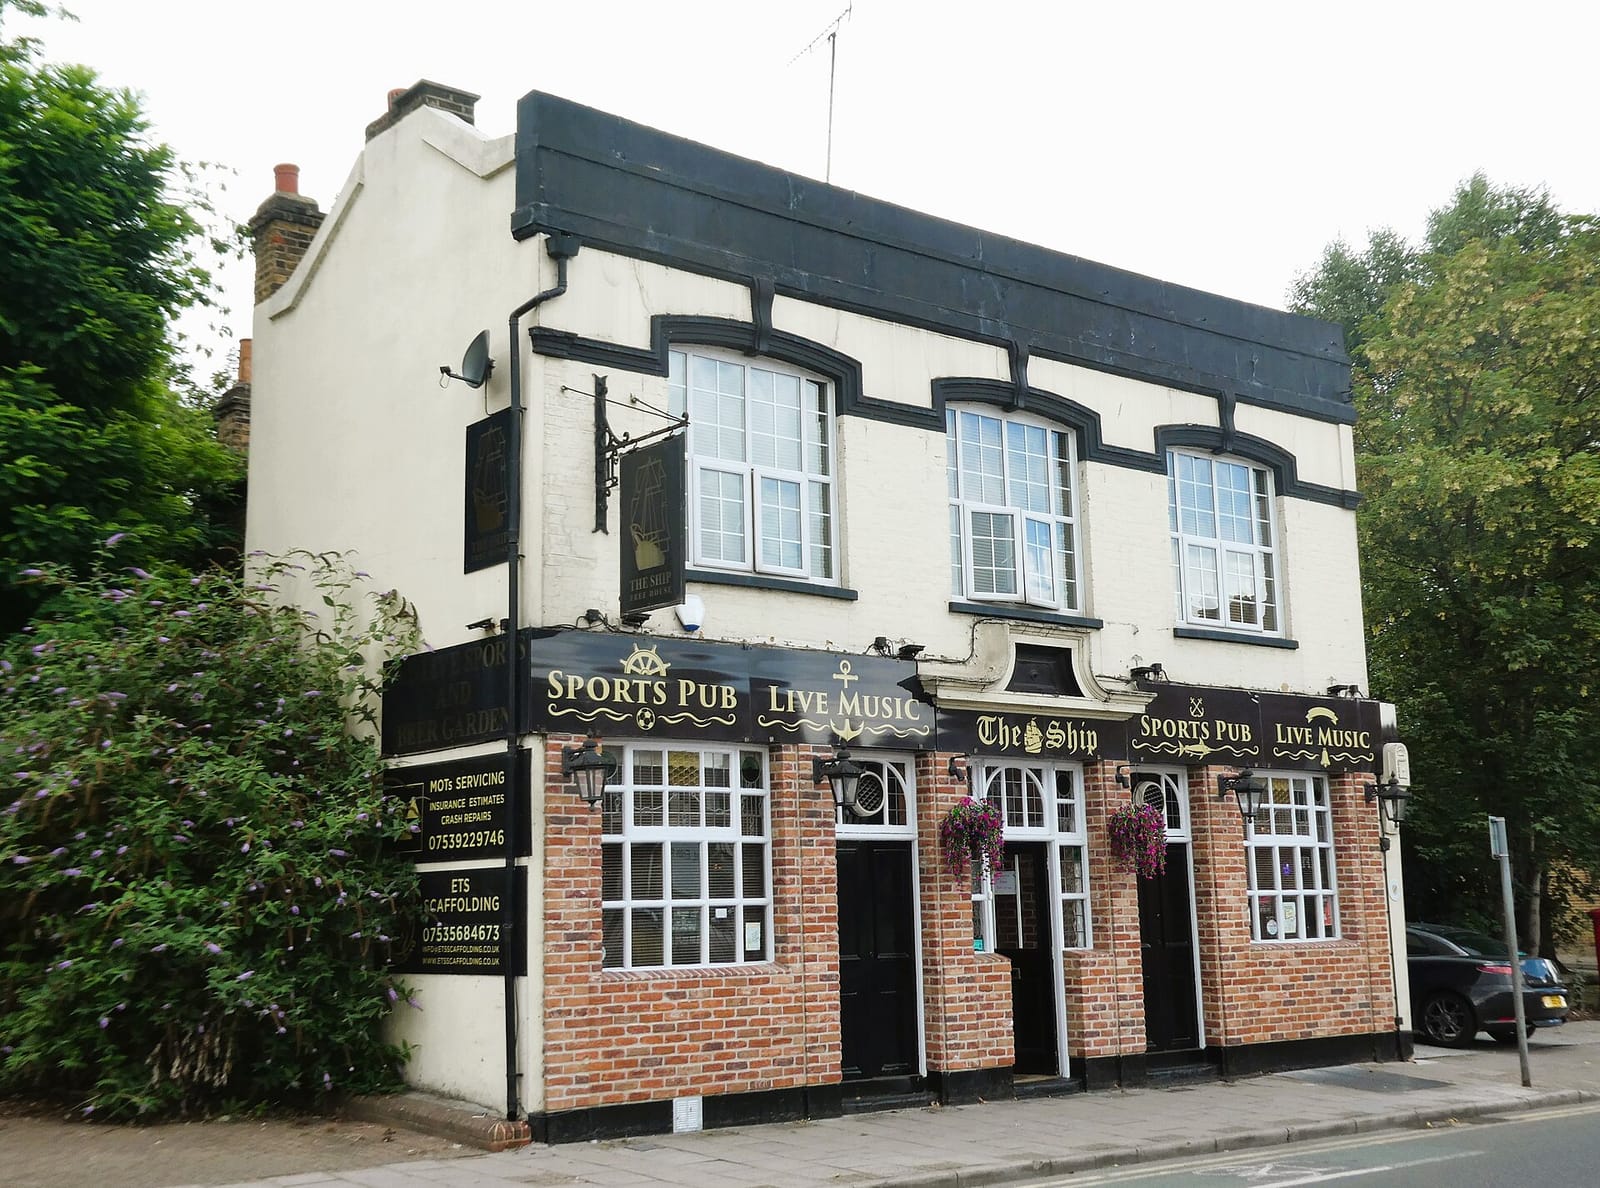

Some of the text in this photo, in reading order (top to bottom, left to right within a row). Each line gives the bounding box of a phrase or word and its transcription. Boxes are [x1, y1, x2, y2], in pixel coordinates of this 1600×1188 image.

[629, 571, 672, 593] THE SHIP
[465, 637, 526, 673] SPORS
[547, 669, 738, 709] SPORTS PUB
[768, 685, 920, 721] LIVE MUSIC
[976, 714, 1098, 756] The Ship
[1140, 714, 1252, 743] SPORTS PUB
[1275, 723, 1370, 749] LIVE MUSIC
[430, 771, 505, 793] MOTs SERVICING
[429, 794, 505, 811] INSURANCE ESTIMATES
[441, 811, 492, 825] CRASH REPAIRS
[428, 830, 505, 850] 07539229746
[451, 878, 470, 893] ETS
[423, 925, 500, 942] 07535684673
